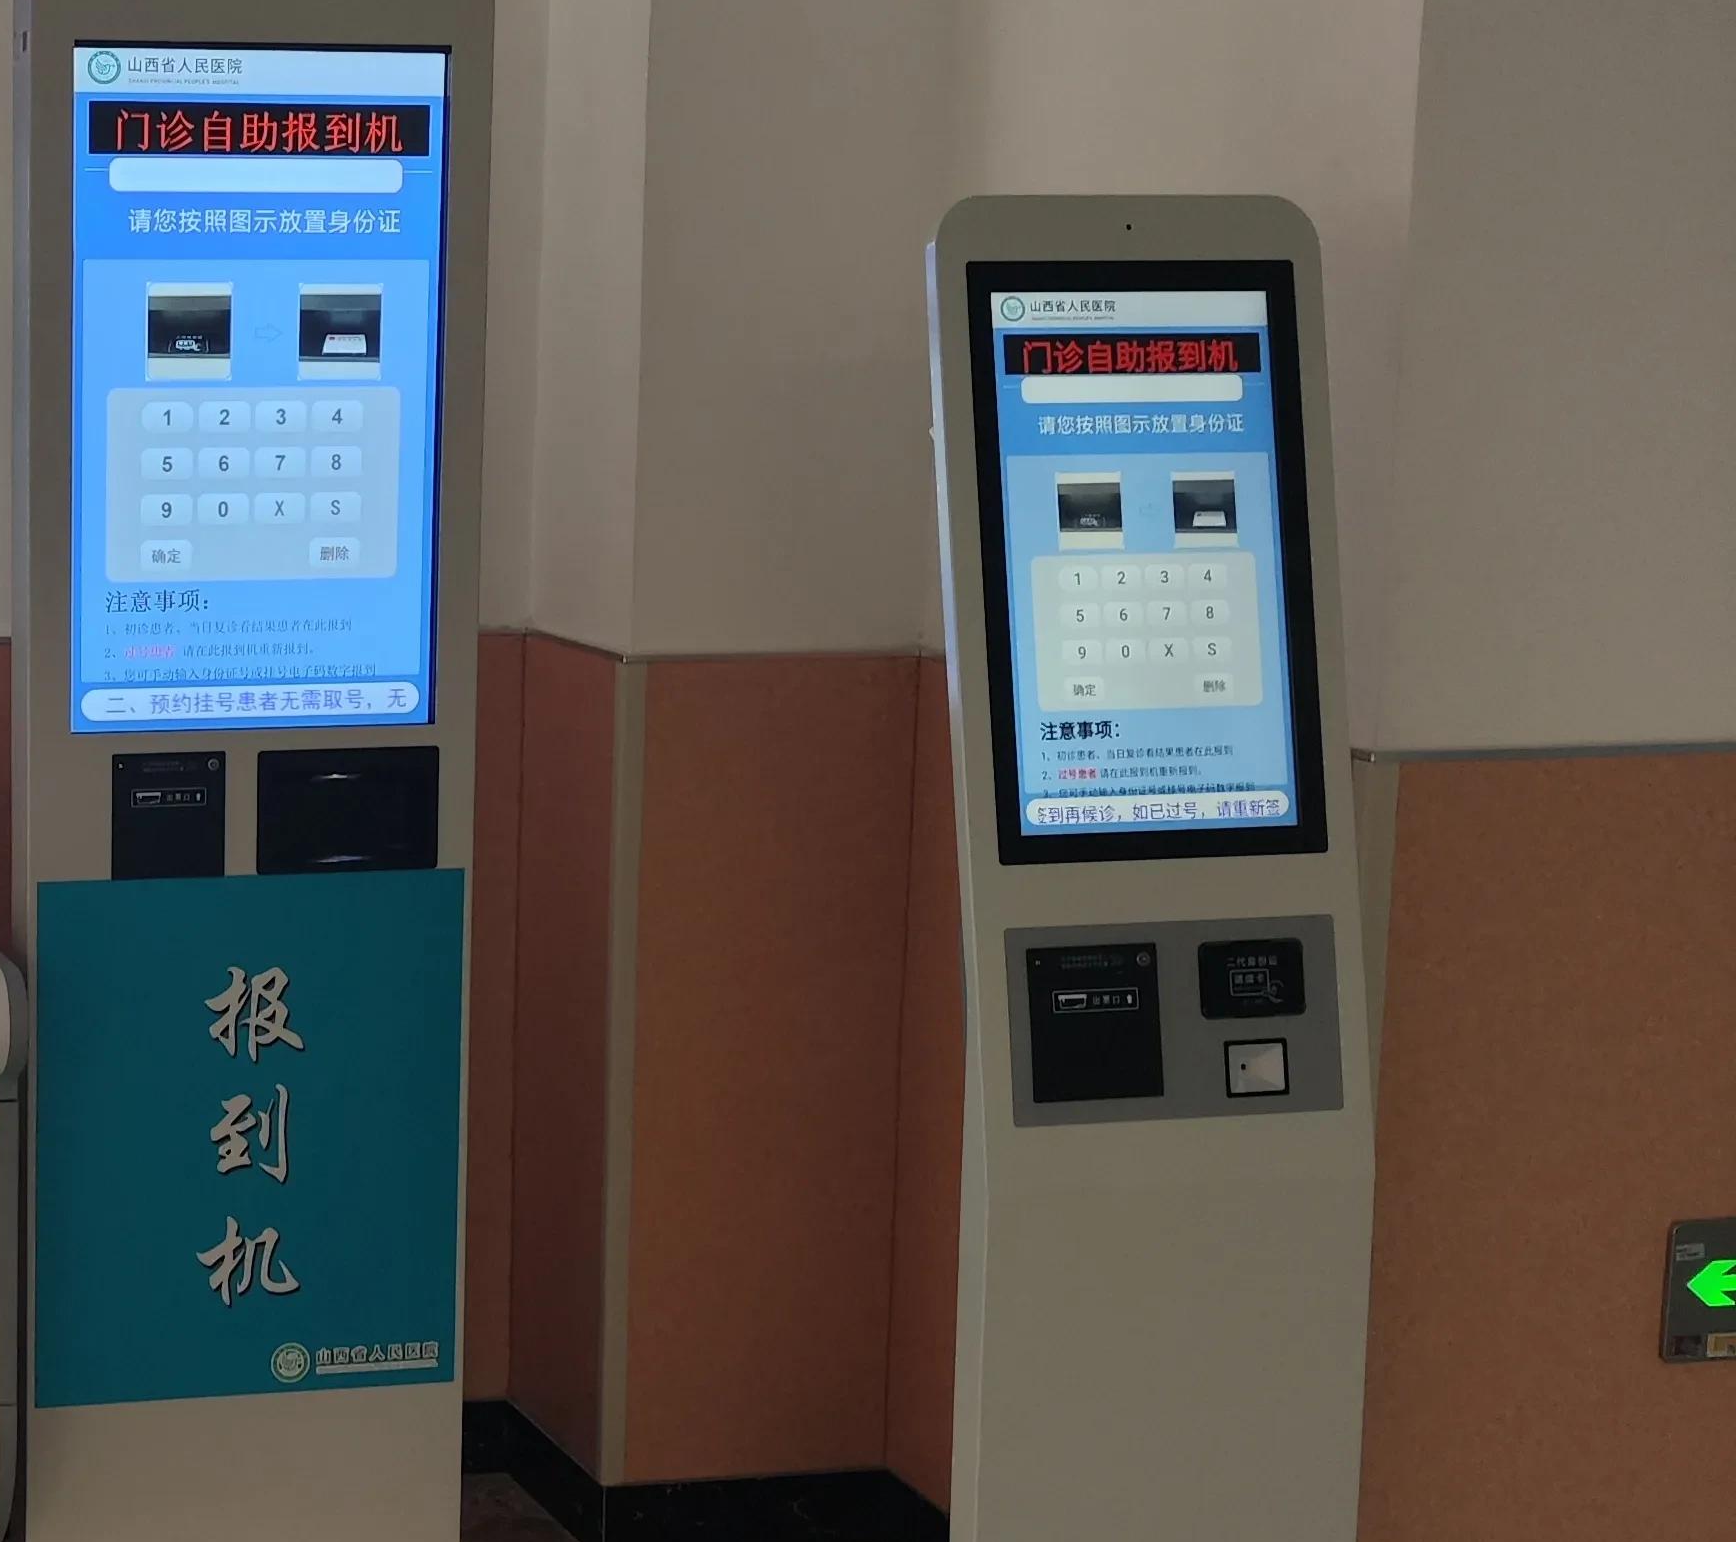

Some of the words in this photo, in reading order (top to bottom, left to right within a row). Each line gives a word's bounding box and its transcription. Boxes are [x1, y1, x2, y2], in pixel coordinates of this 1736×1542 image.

[128, 56, 242, 74] 山西省人民医院
[115, 108, 403, 154] 门诊自助报到机
[128, 209, 401, 234] 请您按照图示放置身份证
[1031, 300, 1115, 312] 山西省人民医院
[1022, 339, 1238, 374] 门诊自助报到机
[163, 410, 171, 425] 1
[219, 409, 230, 426] 2
[276, 409, 286, 425] 3
[332, 409, 343, 424] 4
[1038, 413, 1244, 435] 请您按照图示放置身份证
[162, 457, 172, 472] 5
[219, 456, 229, 472] 6
[276, 455, 285, 471] 7
[332, 455, 341, 470] 8
[161, 502, 172, 518] 9
[218, 502, 228, 518] 0
[274, 501, 284, 516] X
[331, 500, 340, 516] S
[152, 549, 181, 565] 确定
[320, 547, 349, 562] 删除
[1074, 573, 1081, 585] 1
[1117, 572, 1126, 584] 2
[1160, 571, 1169, 583] 3
[1203, 570, 1212, 582] 4
[1076, 609, 1084, 622] 5
[1119, 608, 1128, 621] 6
[1163, 607, 1171, 620] 7
[1206, 606, 1214, 619] 8
[1078, 646, 1086, 659] 9
[1121, 645, 1130, 658] 0
[1164, 644, 1174, 657] X
[1208, 643, 1216, 656] S
[1073, 683, 1096, 697] 确定
[1203, 680, 1226, 693] 删除
[195, 966, 304, 1305] 报到机
[316, 1341, 439, 1365] 山西省人民医院
